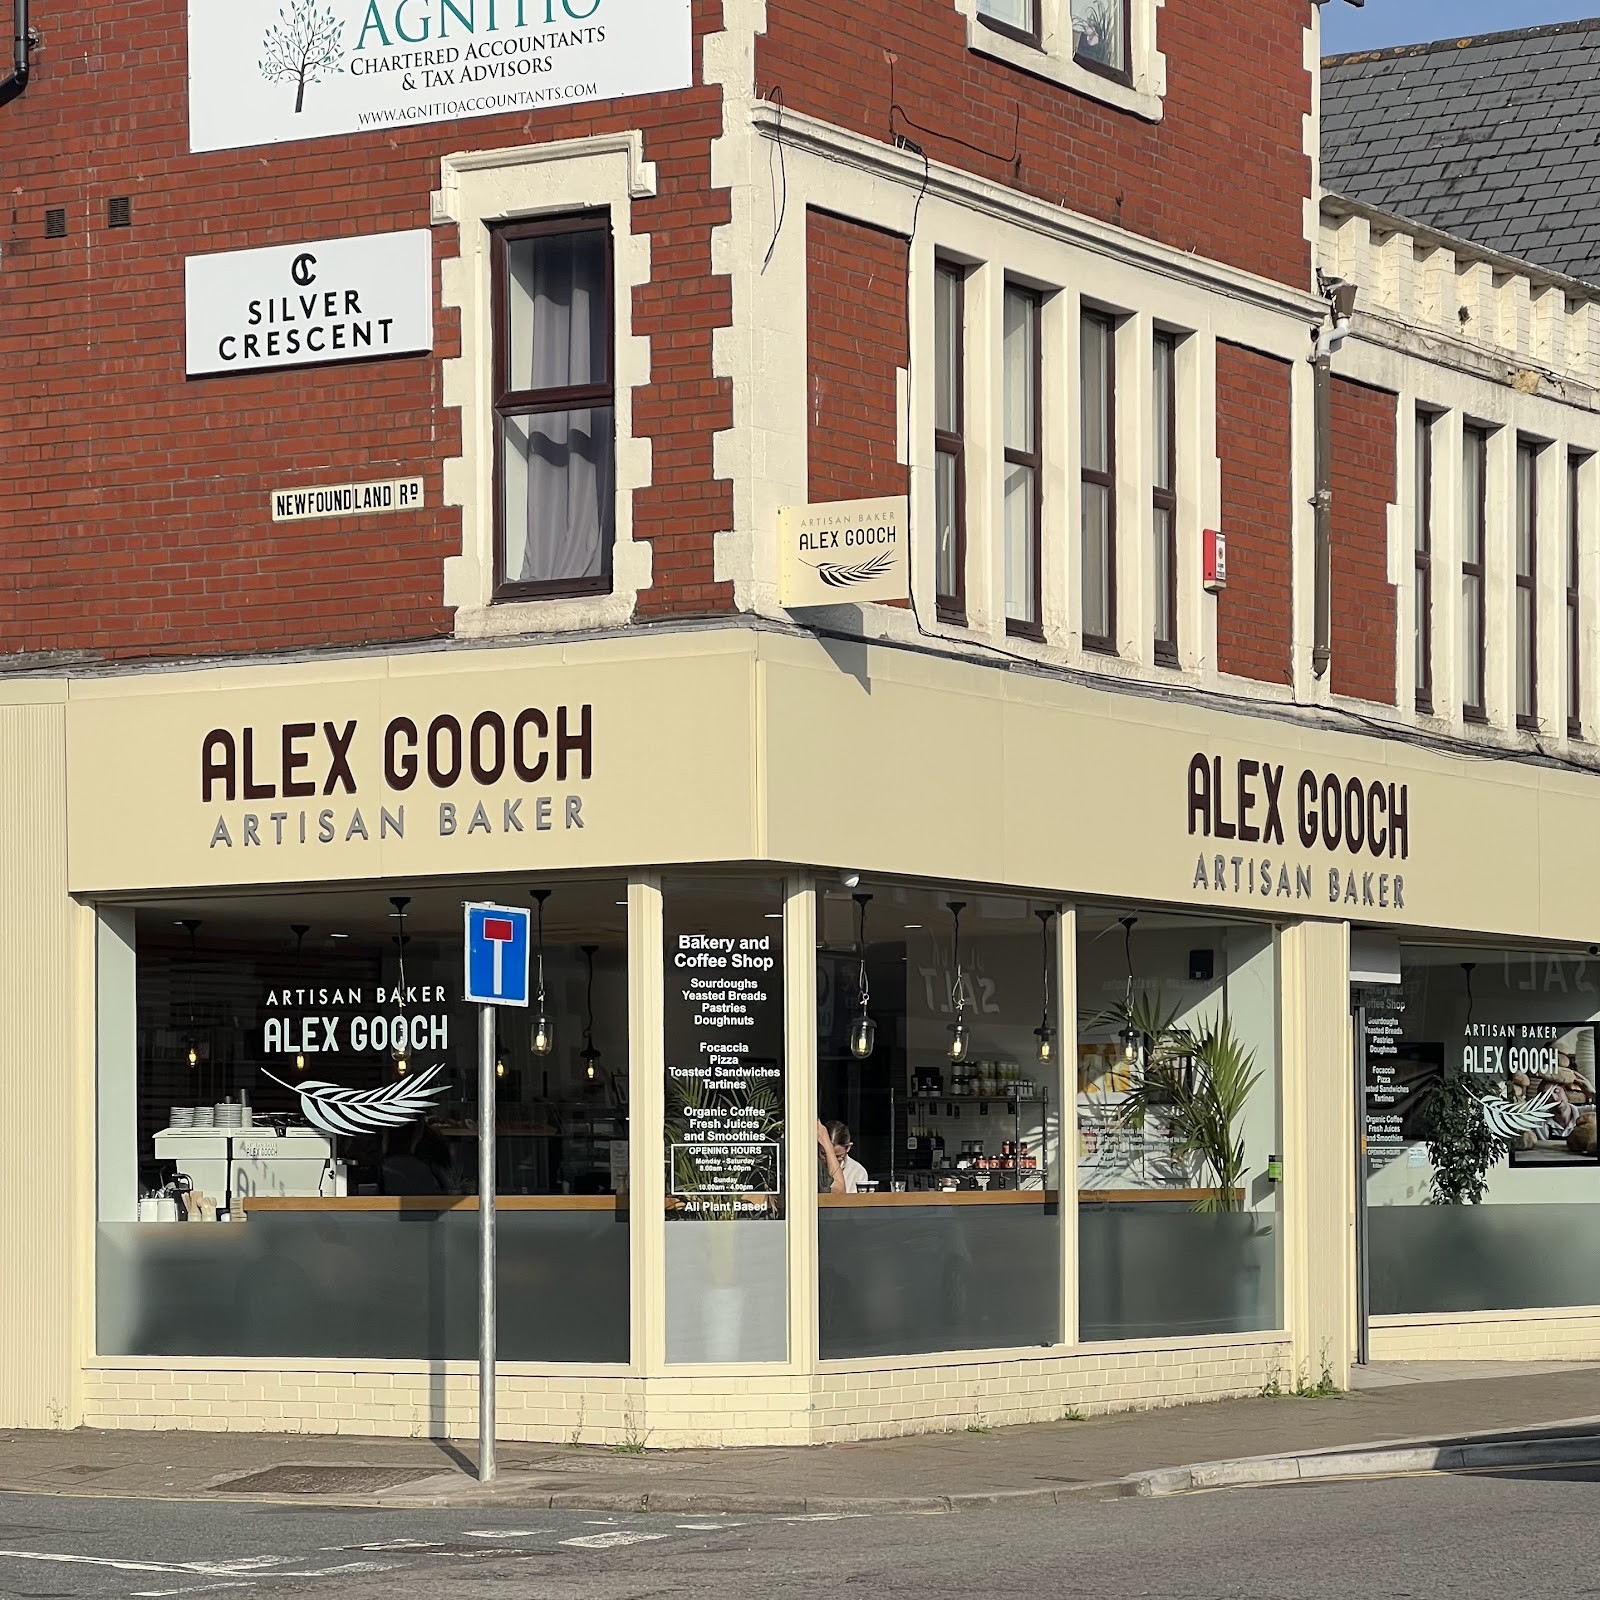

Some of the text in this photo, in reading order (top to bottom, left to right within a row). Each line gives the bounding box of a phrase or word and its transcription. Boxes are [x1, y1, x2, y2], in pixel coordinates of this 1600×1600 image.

[350, 25, 606, 76] CHARTERED ACCOUNTANTS
[402, 55, 553, 91] & TAX ADVISORS
[358, 82, 598, 125] WWW.AGNITIOACCOUNTANTS.COM
[248, 289, 362, 325] SILVER
[218, 318, 393, 361] CRESCENT
[277, 485, 391, 516] NEWFOUNDLAND
[800, 511, 895, 527] ARTISAN BAKER
[799, 525, 896, 550] ALEX GOOCH
[202, 704, 592, 803] ALEX GOOCH
[1187, 752, 1409, 860] ALEX GOOCH
[209, 795, 585, 848] ARTISAN BAKER
[1193, 851, 1405, 909] ARTISAN BAKER
[678, 934, 770, 953] Bakery and
[674, 953, 774, 972] Coffee Shop
[690, 977, 758, 991] Sourdoughs
[266, 985, 446, 1006] ARTISAN BAKER
[682, 990, 767, 1001] Yeasted Breads
[702, 1002, 747, 1013] Pastries
[1366, 998, 1406, 1013] offee Shop
[694, 1014, 754, 1027] Doughnuts
[264, 1014, 448, 1053] ALEX GOOCH
[1385, 1026, 1403, 1034] Breads
[1464, 1023, 1558, 1039] ARTISAN BAKER
[1373, 1035, 1394, 1044] Pastries
[699, 1042, 749, 1053] Focaccia
[1369, 1044, 1398, 1055] Doughnuts
[709, 1055, 739, 1065] Pizza
[1463, 1045, 1559, 1075] ALEX GOOCH
[668, 1066, 780, 1077] Toasted Sandwiches
[1372, 1065, 1396, 1075] Focaccia
[702, 1079, 747, 1089] Tartines
[1377, 1075, 1391, 1084] Pizza
[1365, 1085, 1410, 1093] asted Sandwiches
[1374, 1094, 1395, 1102] Tartines
[683, 1106, 766, 1119] Organic Coffee
[689, 1118, 760, 1129] Fresh Juices
[1366, 1115, 1404, 1124] Organic Coffee
[1368, 1124, 1401, 1133] Fresh Juices
[683, 1131, 766, 1141] and Smoothies
[1376, 1134, 1404, 1142] Smoothies
[689, 1146, 762, 1155] OPENING HOURS
[695, 1157, 721, 1165] Monday
[726, 1157, 755, 1165] Saturday
[713, 1176, 738, 1184] Sunday
[685, 1201, 768, 1212] All Plant Based
